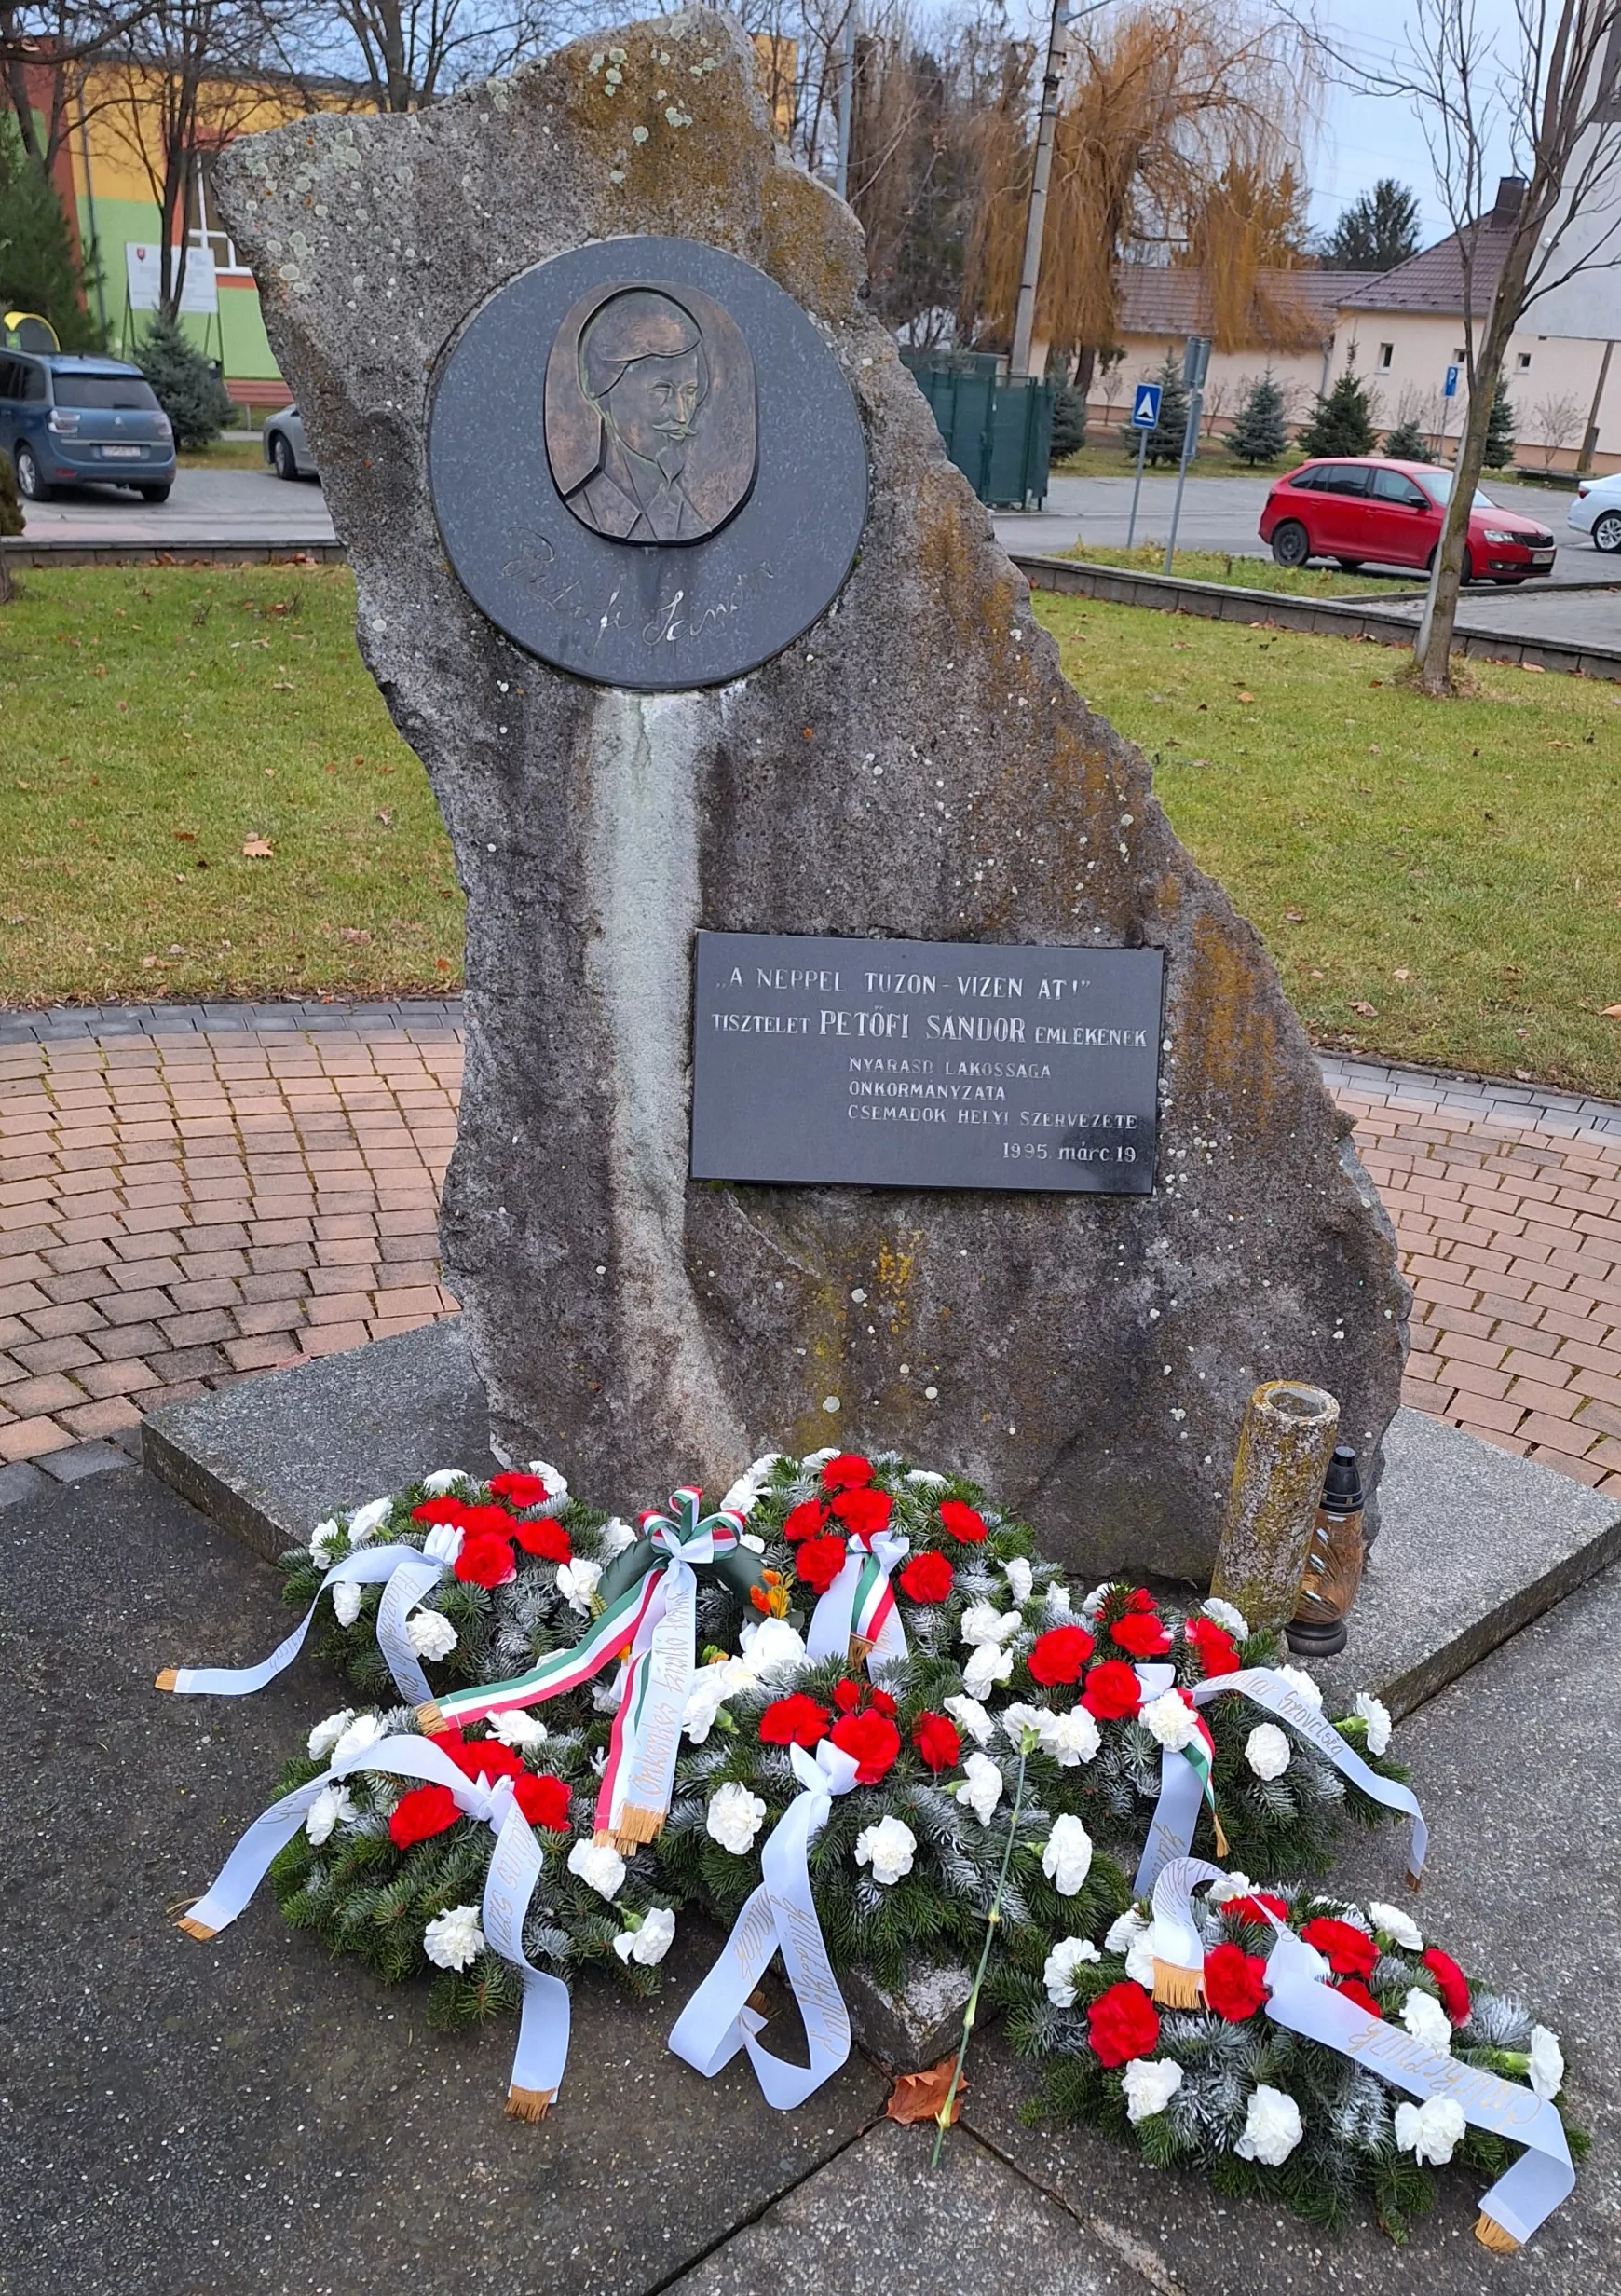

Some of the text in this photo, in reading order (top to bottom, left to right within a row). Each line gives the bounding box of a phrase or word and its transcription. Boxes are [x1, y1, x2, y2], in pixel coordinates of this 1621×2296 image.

[711, 1013, 811, 1034] TISZTELET
[847, 1104, 1138, 1130] CSEMADOK HELYI SZERVEZETE
